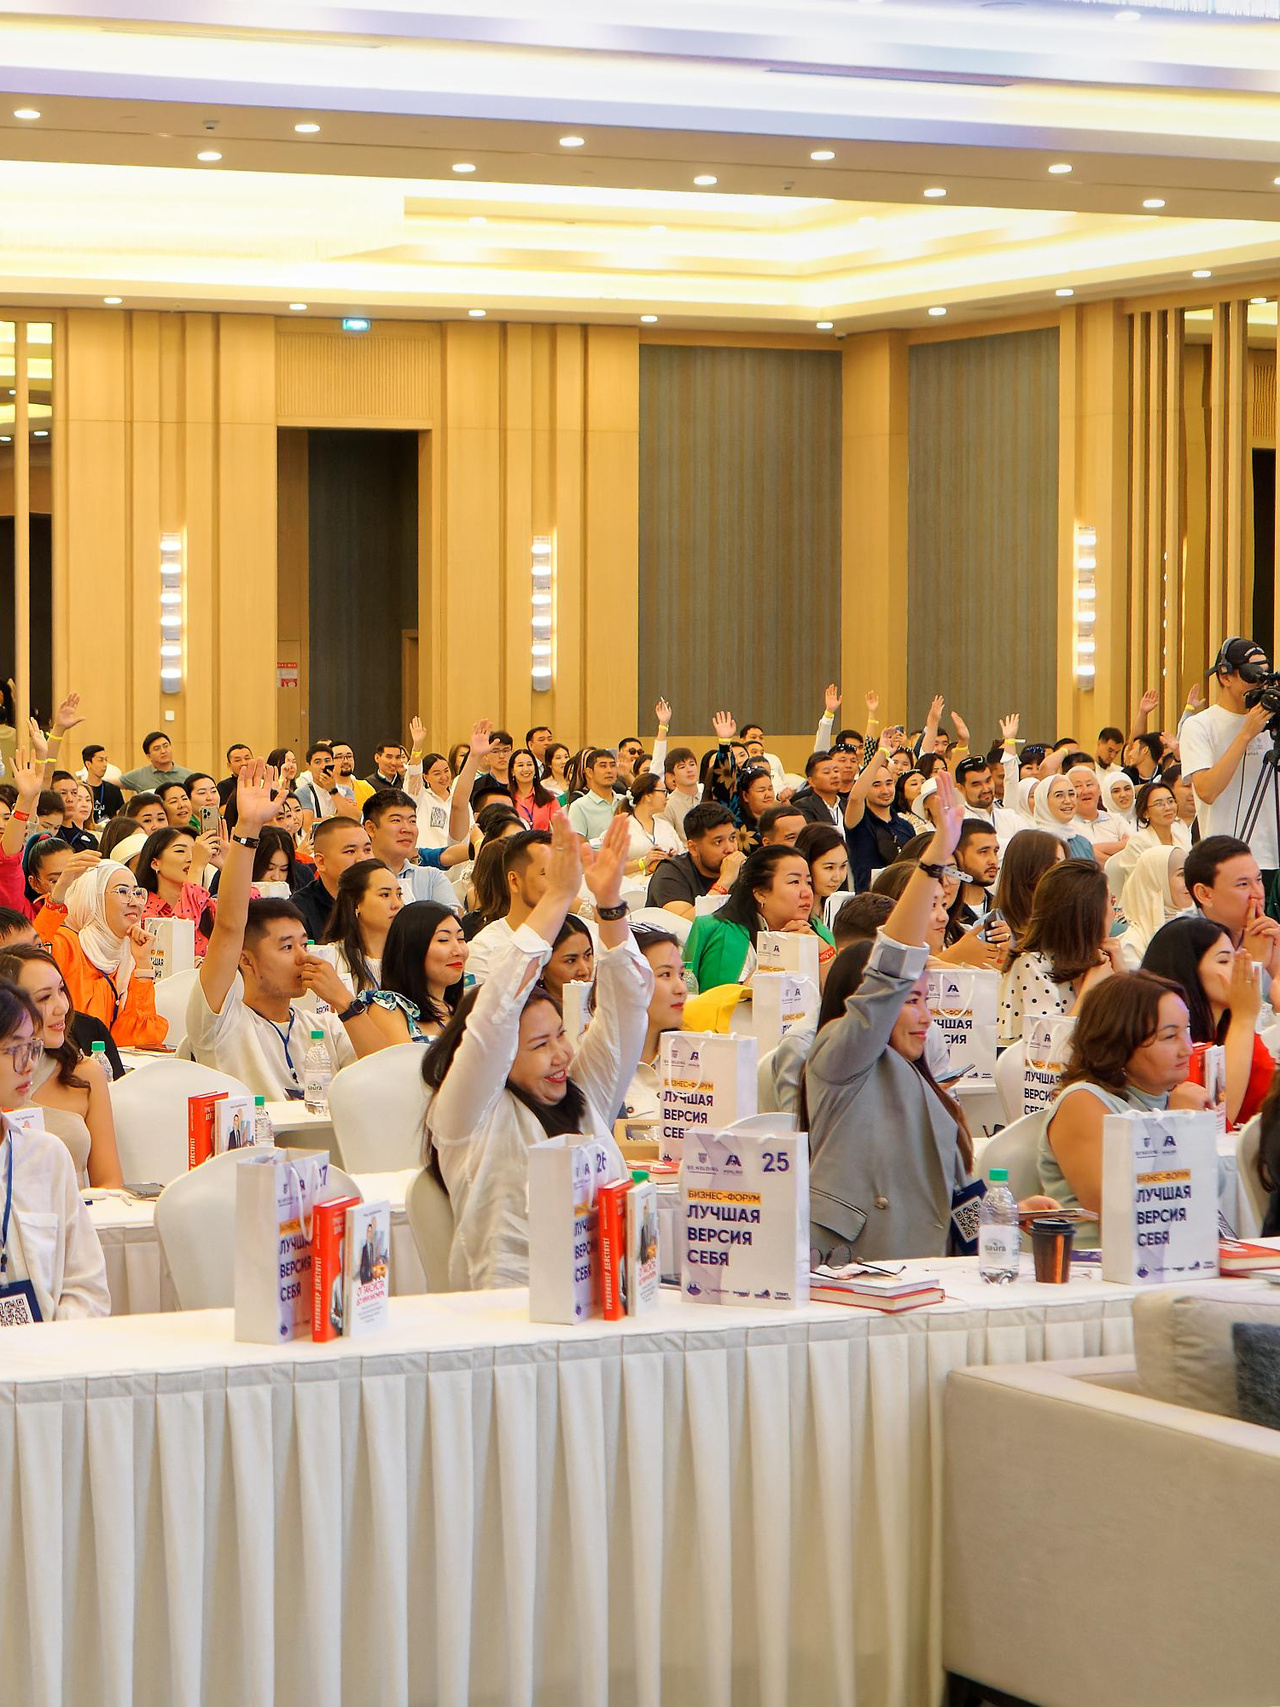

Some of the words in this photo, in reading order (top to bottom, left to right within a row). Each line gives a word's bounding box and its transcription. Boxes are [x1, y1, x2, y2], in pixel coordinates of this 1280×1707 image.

[664, 1091, 714, 1107] ЛУЧШАЯ
[664, 1108, 708, 1124] ВЕРСИЯ
[663, 1126, 686, 1139] СЕБ
[762, 1152, 790, 1172] 25
[688, 1191, 761, 1203] БИЗНЕС-ФОРУМ
[1136, 1185, 1192, 1203] ЛУЧШАЯ
[687, 1204, 761, 1223] ЛУЧШАЯ
[1137, 1207, 1187, 1226] ВЕРСИЯ
[687, 1227, 752, 1246] ВЕРСИЯ
[1137, 1231, 1170, 1248] СЕБЯ
[687, 1249, 730, 1266] СЕБЯ
[280, 1282, 302, 1302] СЕБЯ
